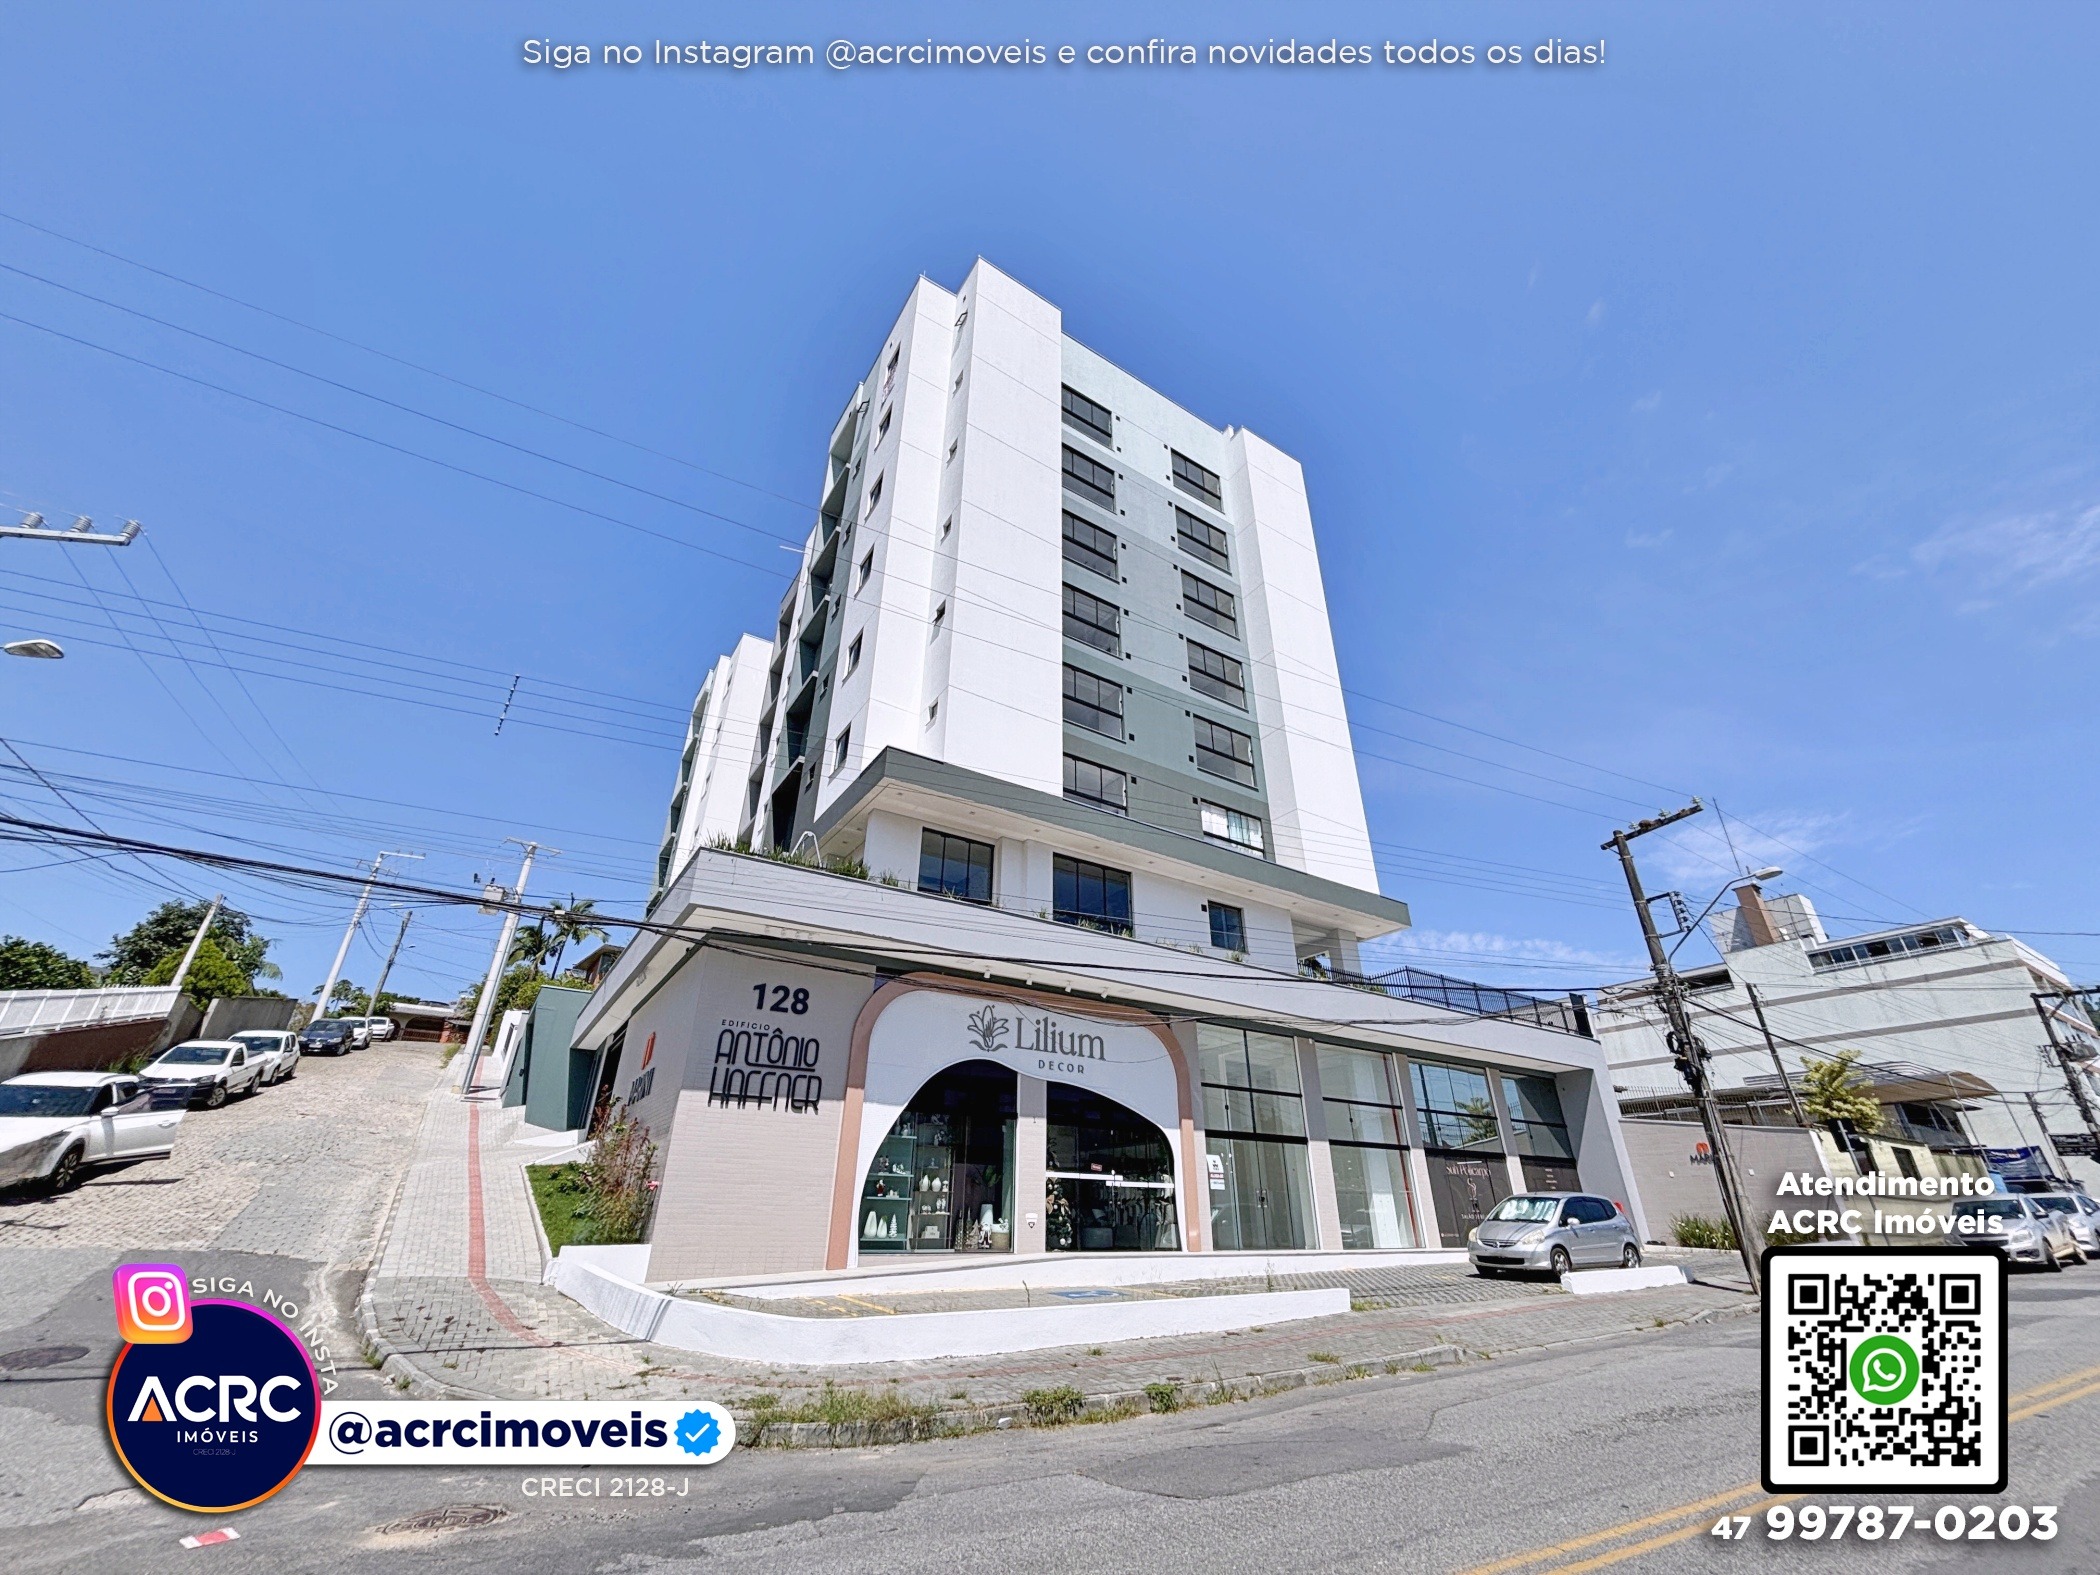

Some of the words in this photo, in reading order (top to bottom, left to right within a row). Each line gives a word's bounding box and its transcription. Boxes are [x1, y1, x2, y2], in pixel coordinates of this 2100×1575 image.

[753, 983, 810, 1015] 128
[715, 1028, 820, 1073] ANTÔNIO
[1015, 1016, 1106, 1061] Lilium
[1038, 1059, 1085, 1074] DECOR
[707, 1066, 823, 1116] HAFFNER
